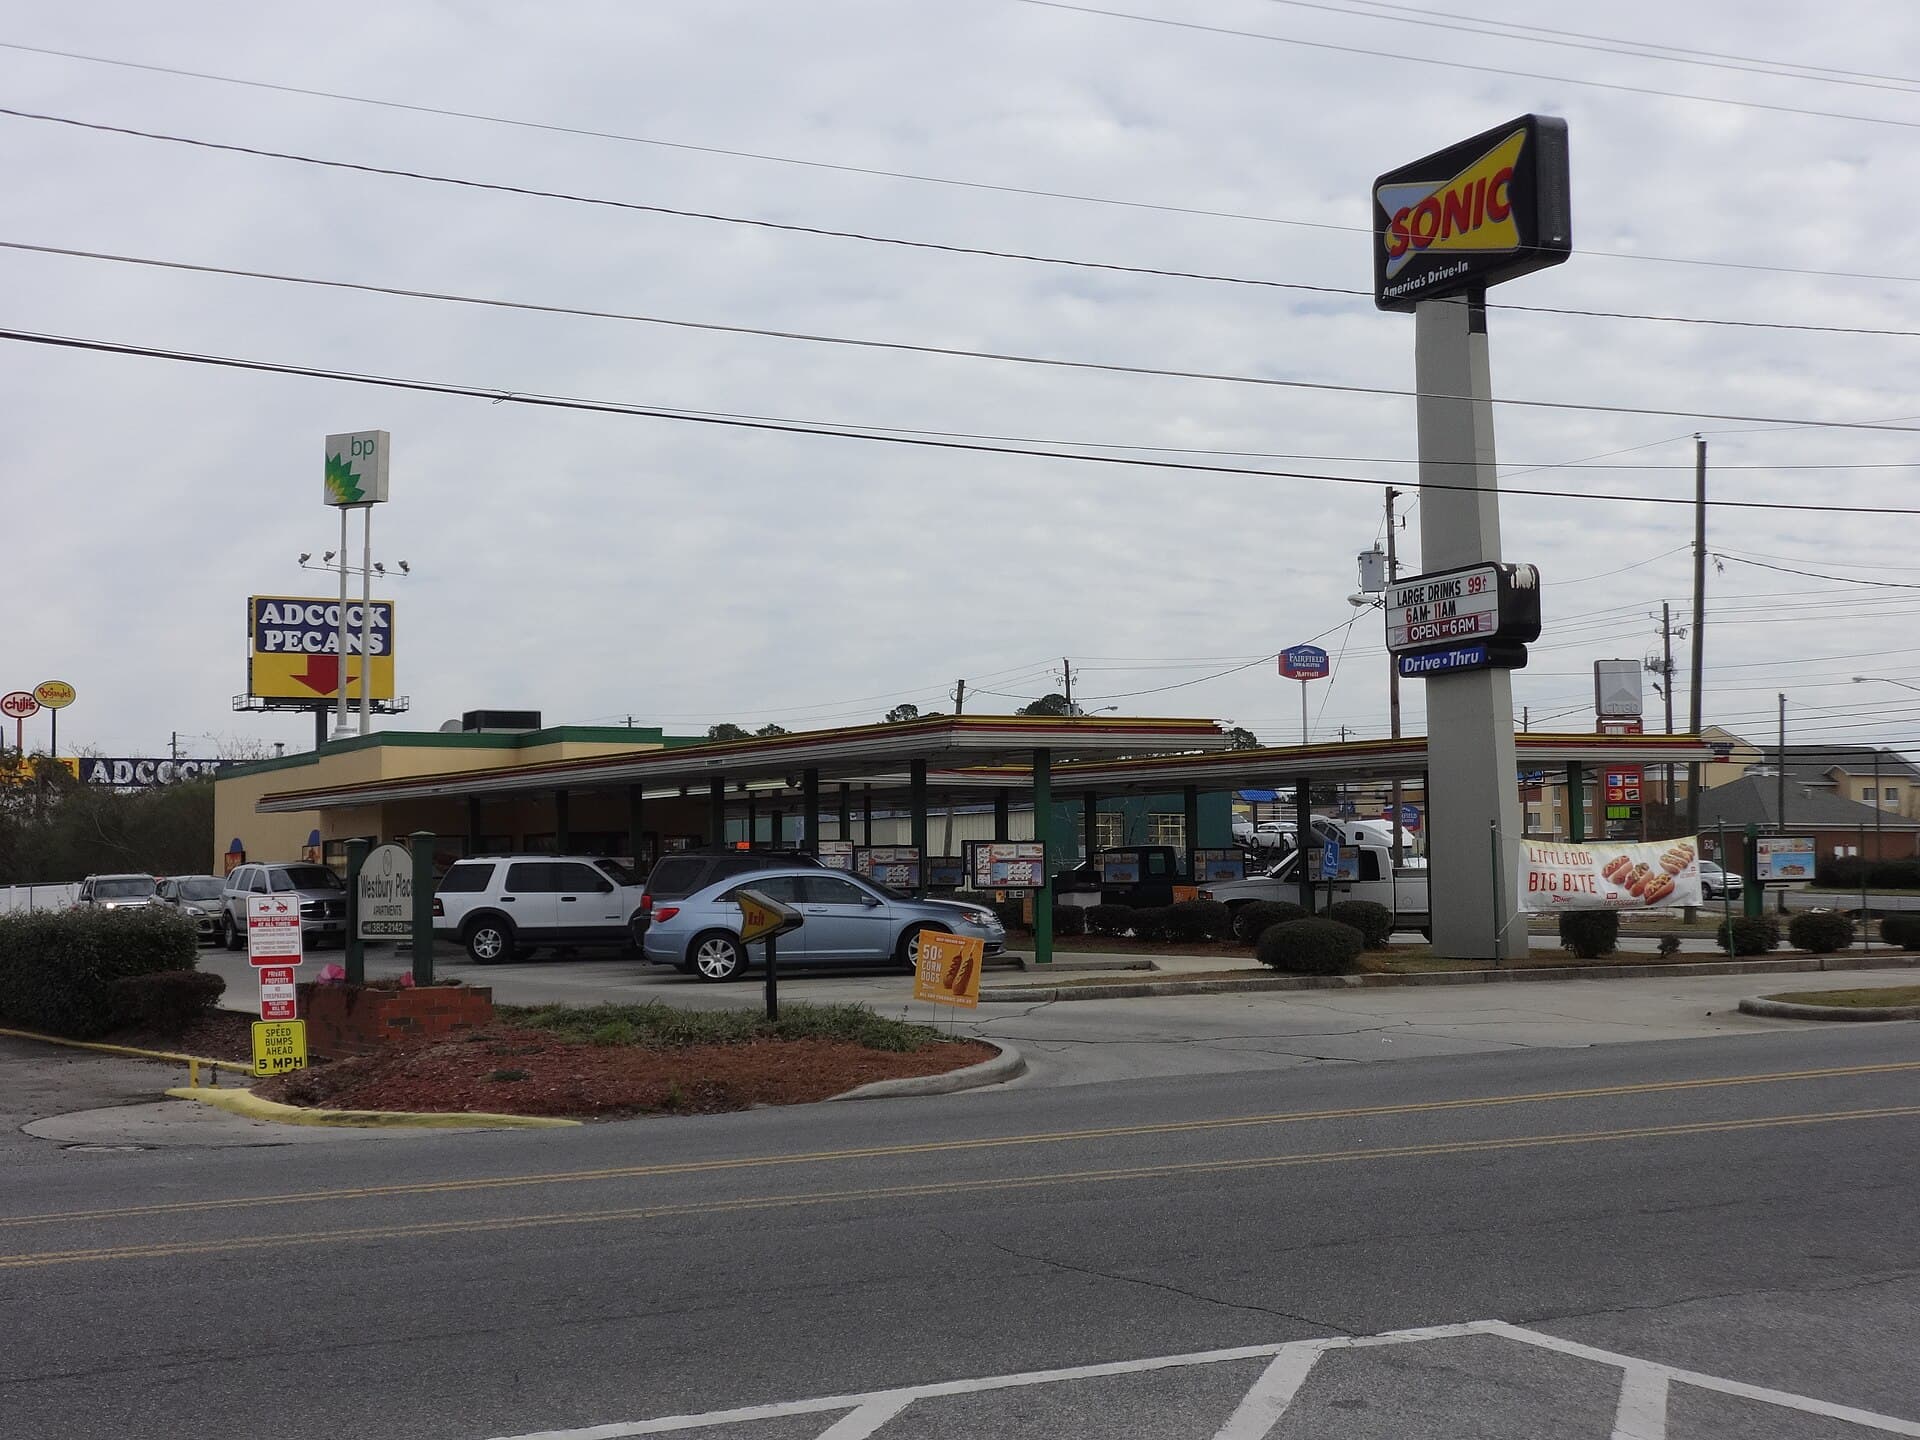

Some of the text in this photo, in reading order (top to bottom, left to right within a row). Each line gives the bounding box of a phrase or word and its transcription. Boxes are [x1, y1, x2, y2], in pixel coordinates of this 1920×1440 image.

[1388, 167, 1513, 260] SONIC
[1382, 273, 1427, 299] America's
[351, 435, 375, 461] bp
[1396, 575, 1487, 606] LARGE DRINKS 99¢
[259, 603, 388, 628] ADCOCK
[1434, 600, 1457, 619] 11AM
[1410, 623, 1440, 641] OPEN
[264, 630, 384, 654] PECANS
[1289, 653, 1325, 663] FAIRFIELD
[1296, 670, 1319, 678] Marriott
[87, 760, 220, 785] ADCOCK
[360, 872, 412, 904] Westbury Plac
[1529, 871, 1597, 894] BIG BITE
[373, 904, 402, 917] APARTMENTS
[922, 944, 943, 961] 50¢
[921, 960, 942, 973] CORN
[920, 971, 941, 984] DOGS
[265, 1028, 291, 1037] SPEED
[265, 1037, 293, 1047] BUMPS
[266, 1046, 293, 1056] AHEAD
[258, 1056, 303, 1069] 5 MPH
